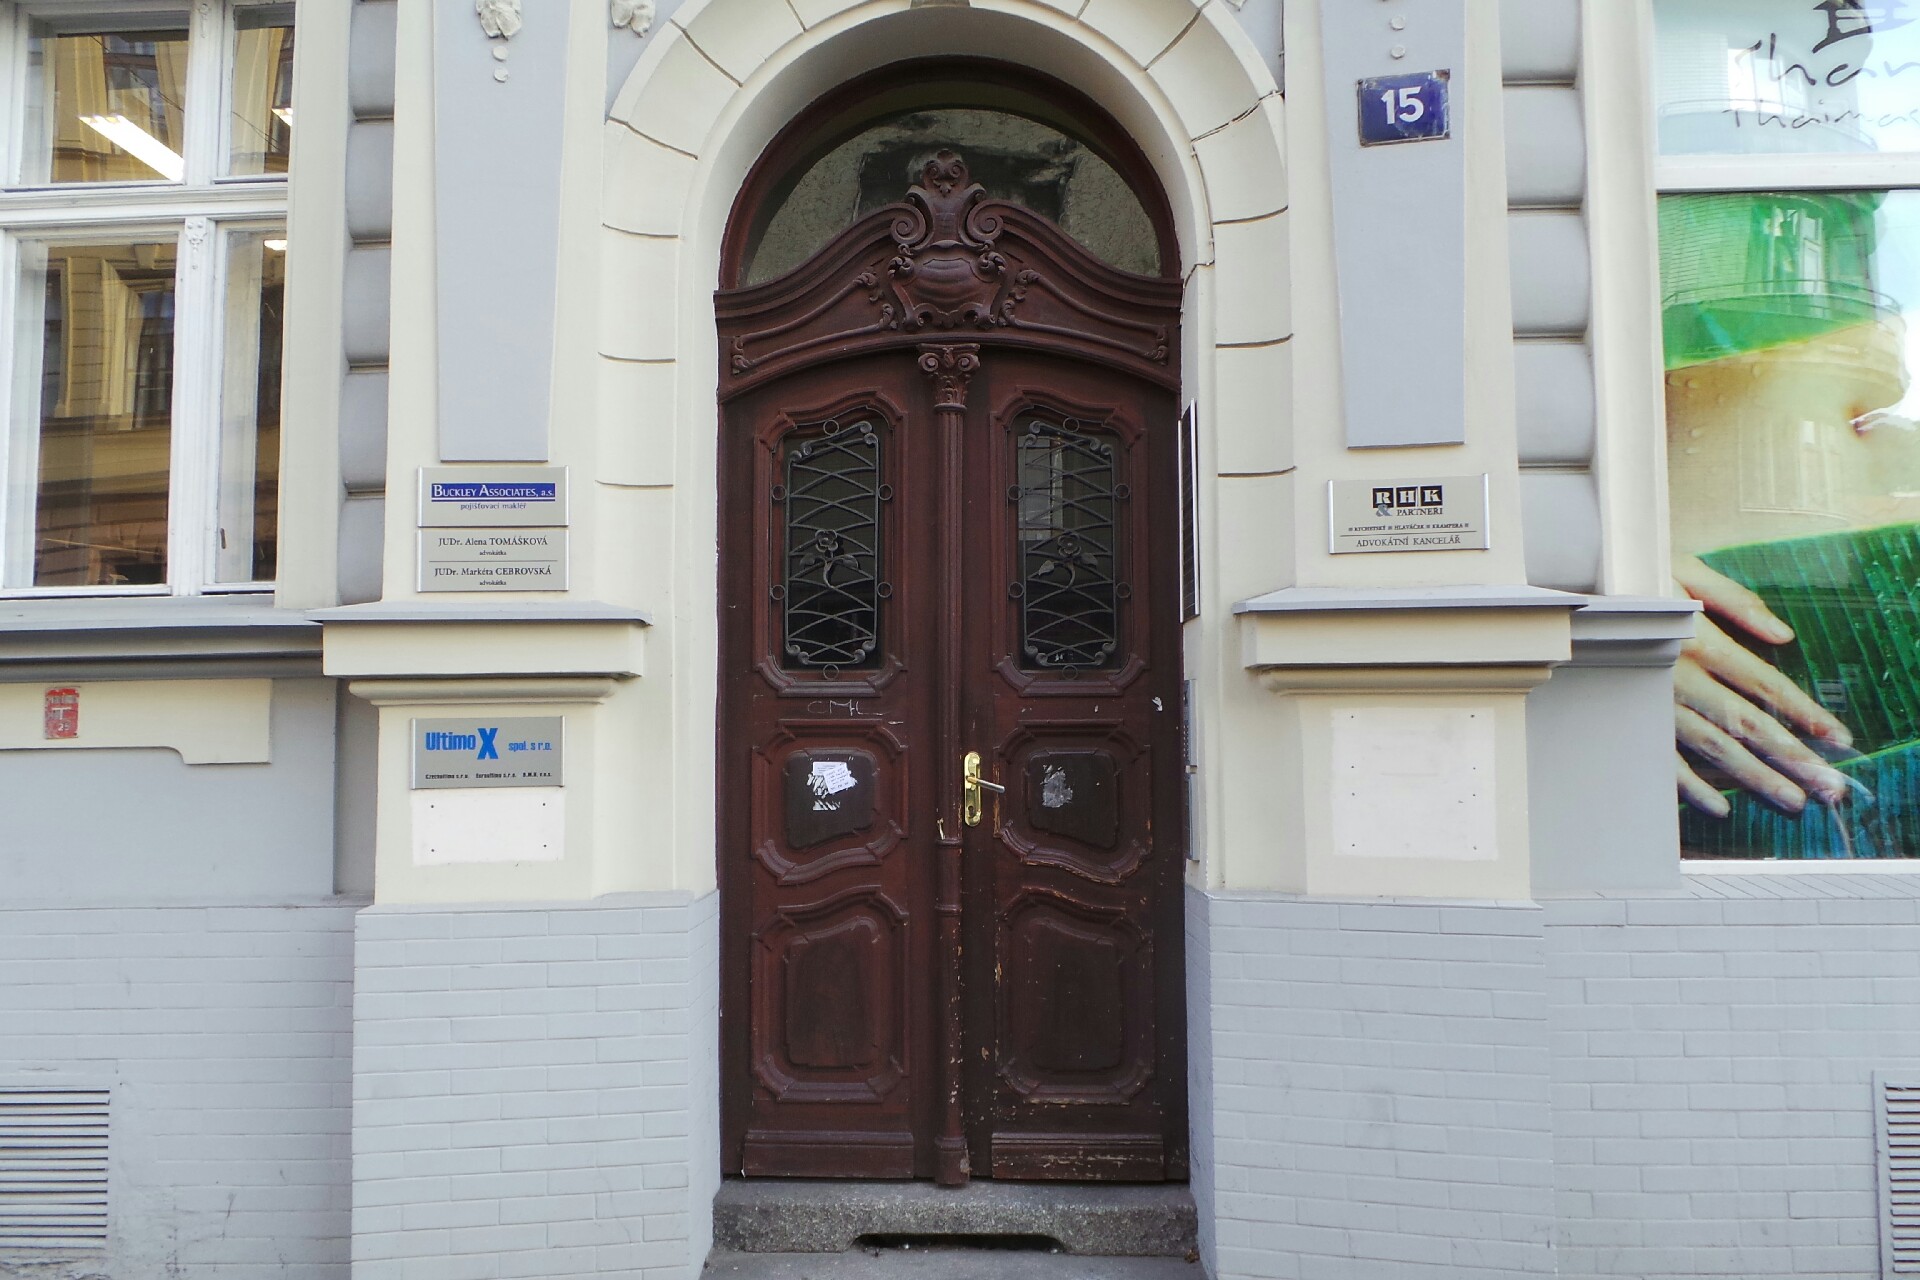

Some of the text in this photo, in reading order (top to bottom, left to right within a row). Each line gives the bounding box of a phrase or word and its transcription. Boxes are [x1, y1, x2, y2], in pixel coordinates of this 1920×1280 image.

[1380, 86, 1424, 125] 15
[541, 489, 554, 497] a.s.
[438, 535, 548, 547] JUDr. Alena TOMÁŠKOVÁ
[1356, 535, 1461, 547] ADVOKÁTNÍ KANCELÁŘ
[434, 565, 552, 577] JUDr. Markéta CEBROVSKÁ
[508, 741, 529, 752] spol.
